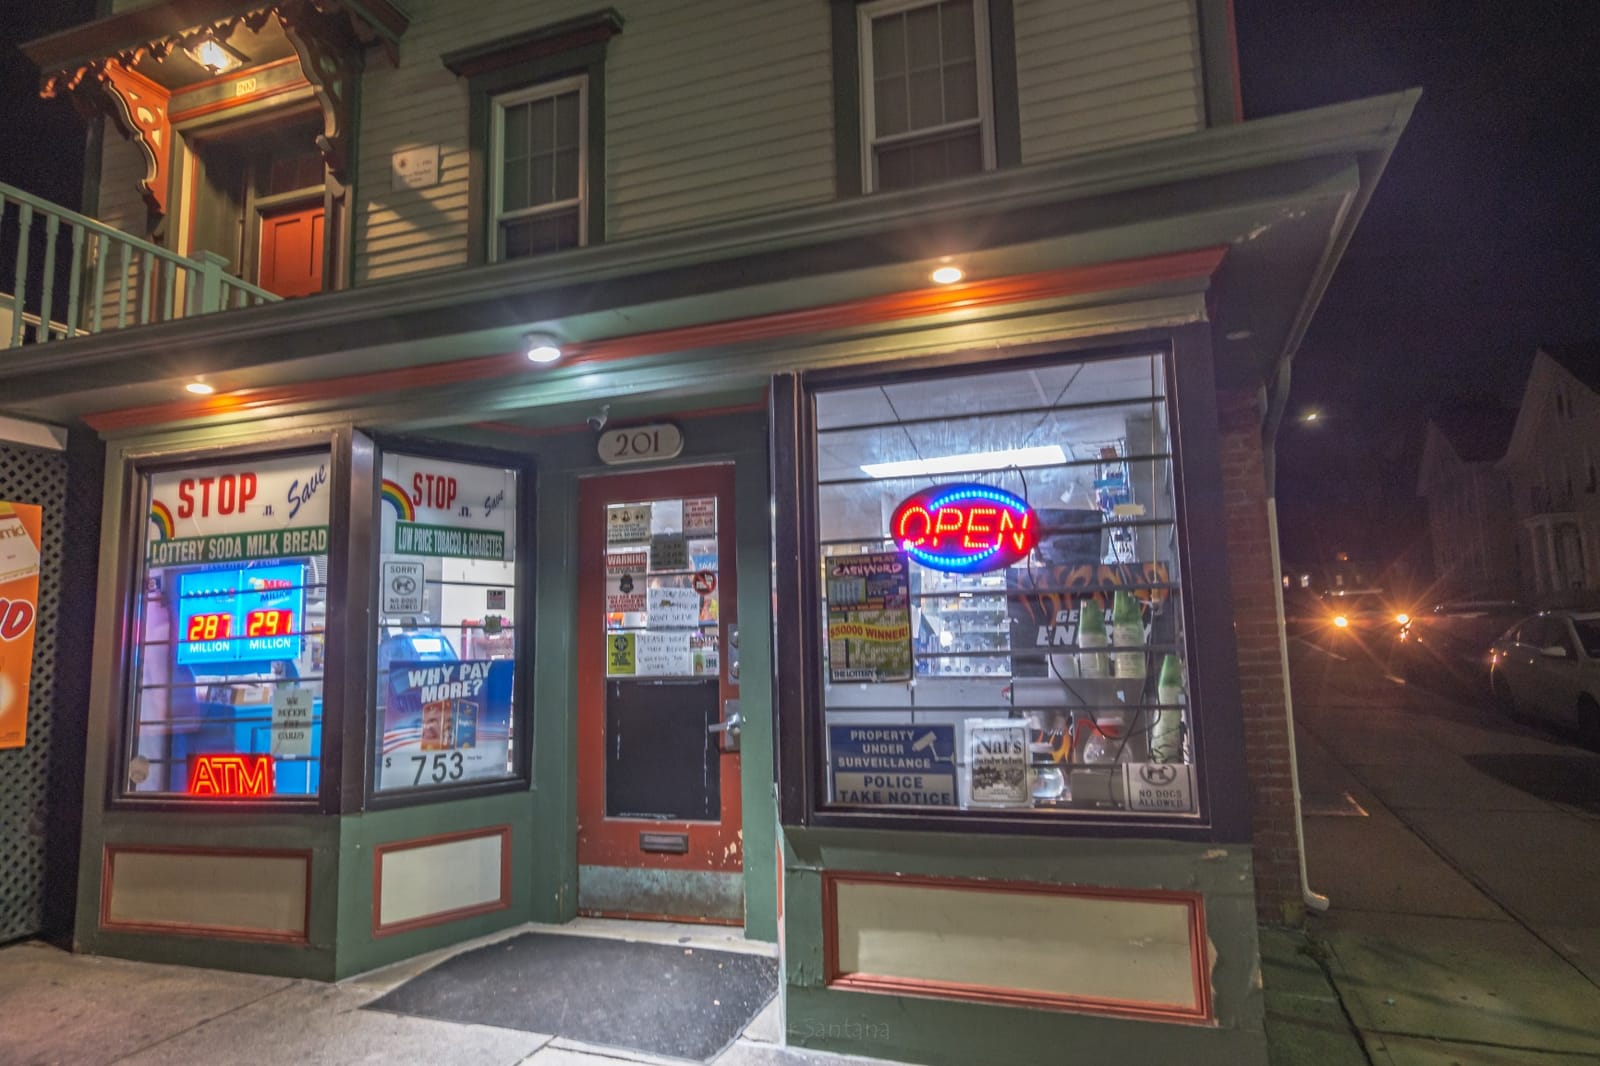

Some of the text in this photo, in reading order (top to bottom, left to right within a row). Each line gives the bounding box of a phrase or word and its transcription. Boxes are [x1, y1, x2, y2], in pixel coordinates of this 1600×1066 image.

[615, 431, 659, 457] 201
[178, 472, 257, 519] STOP
[287, 464, 327, 519] Save
[412, 471, 457, 510] STOP
[484, 489, 504, 518] Save
[900, 506, 1029, 550] OPEN
[152, 529, 327, 565] LOTTERY SODA MILK BREAD
[398, 526, 413, 550] LOW
[414, 528, 433, 552] PRICE
[434, 529, 462, 554] TOBACCO
[468, 532, 503, 557] CIGARETTES
[390, 565, 417, 574] SORRY
[833, 563, 902, 577] CASHWORD
[190, 614, 231, 640] 287
[250, 611, 292, 637] 291
[190, 641, 230, 653] MILLION
[249, 639, 291, 650] MILLION
[408, 661, 493, 688] WHY PAY
[421, 679, 483, 704] MORE?
[850, 730, 914, 740] PROPERTY
[862, 744, 905, 754] UNDER
[385, 757, 392, 768] $
[838, 757, 931, 768] SURVEILLANCE
[190, 757, 269, 795] ATM
[864, 776, 924, 788] POLICE
[840, 791, 951, 805] TAKE NOTICE
[1139, 789, 1182, 798] NO DOGS
[1139, 800, 1184, 808] ALLOWED
